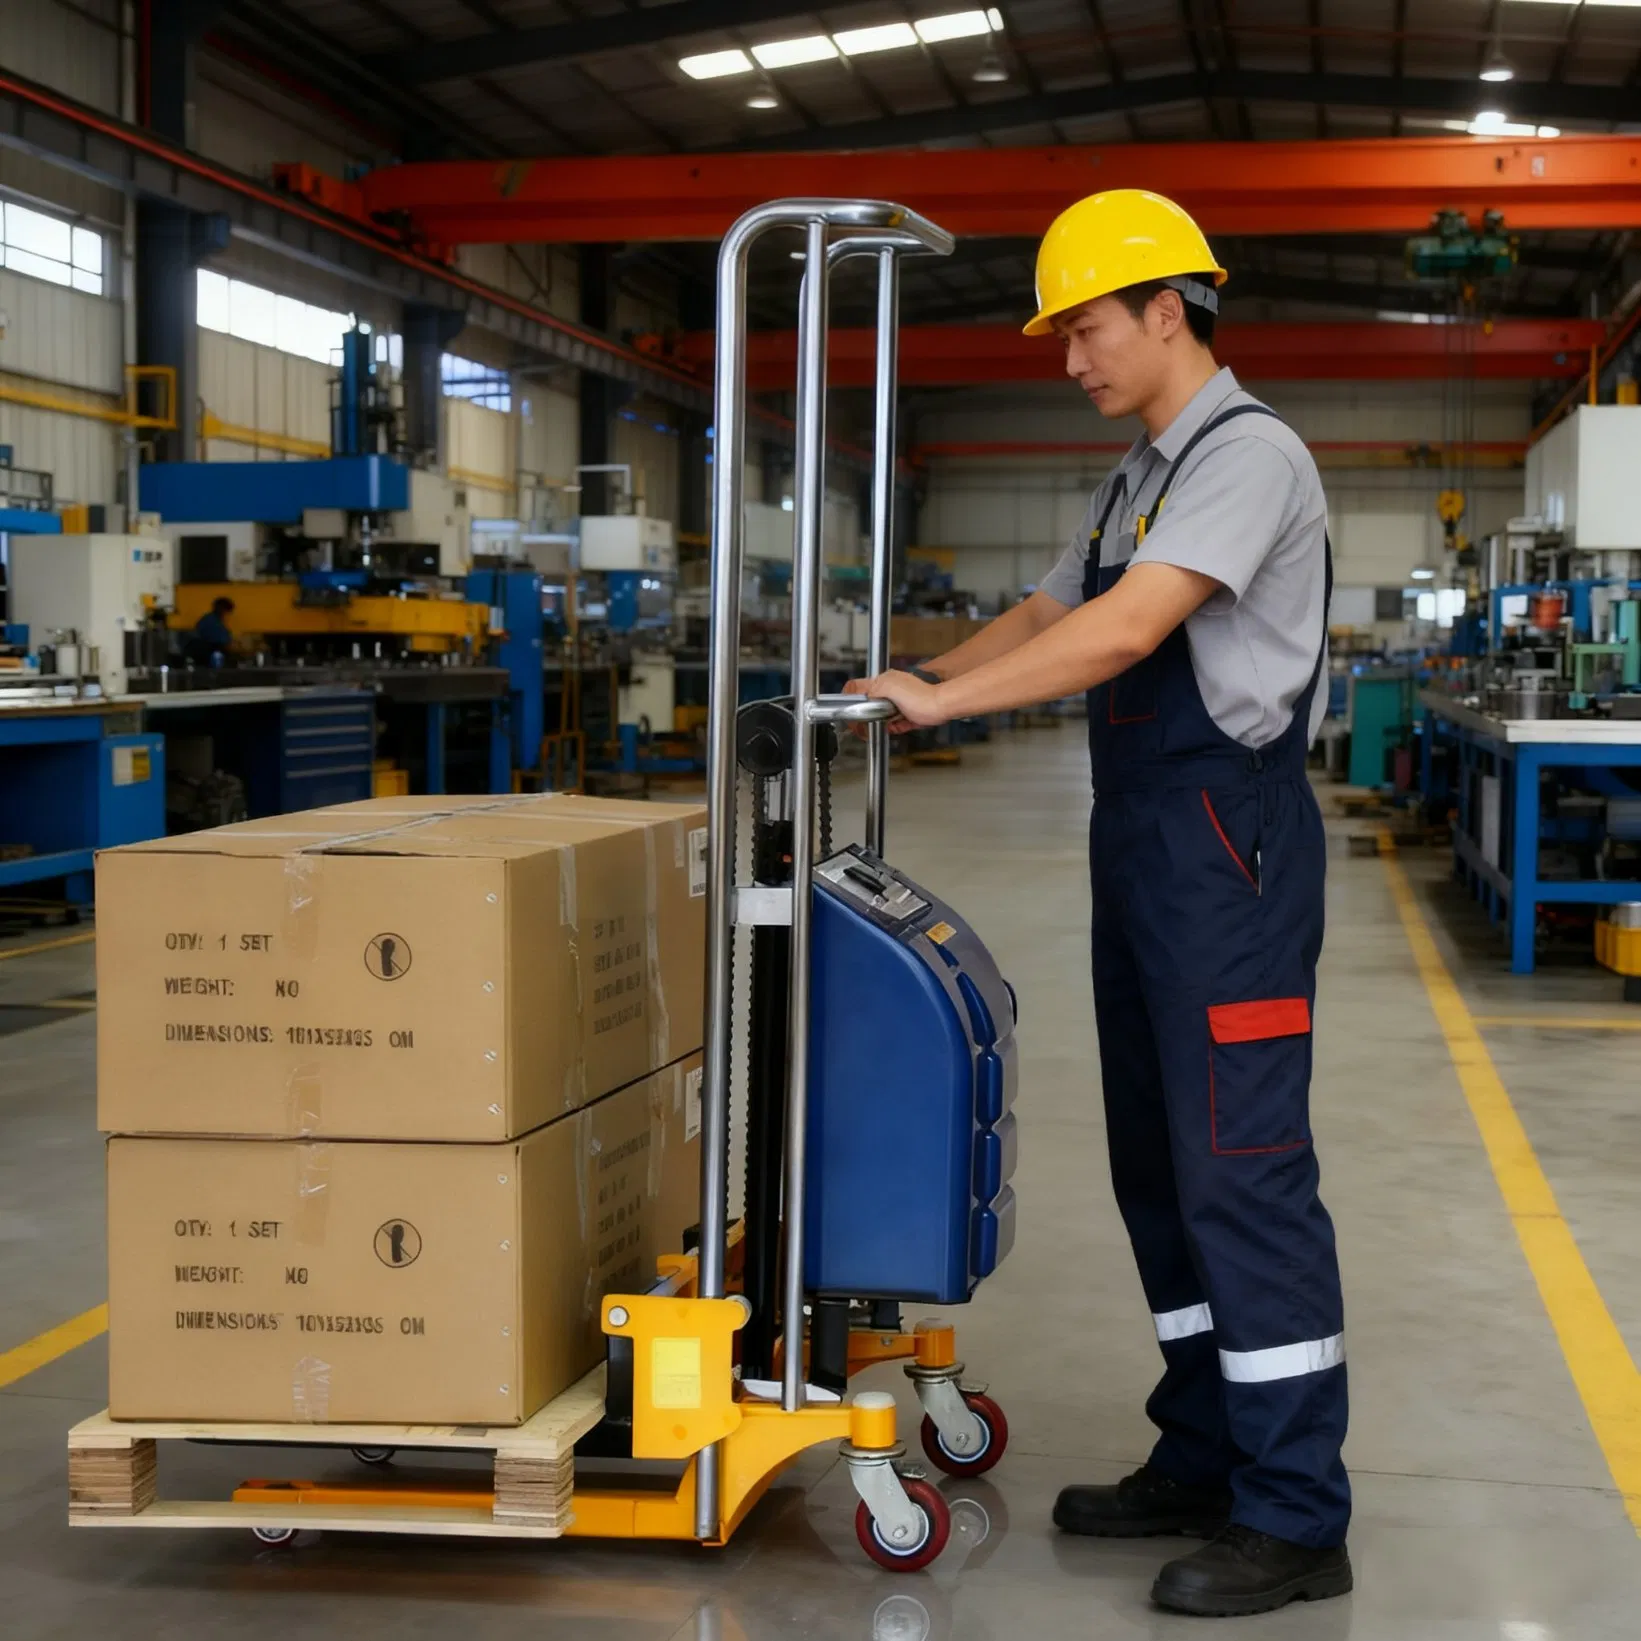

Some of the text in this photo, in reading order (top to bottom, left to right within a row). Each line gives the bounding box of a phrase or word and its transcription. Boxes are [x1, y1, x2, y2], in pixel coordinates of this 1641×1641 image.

[218, 933, 227, 951] 1
[239, 933, 273, 952] SET
[247, 1220, 283, 1239] SET
